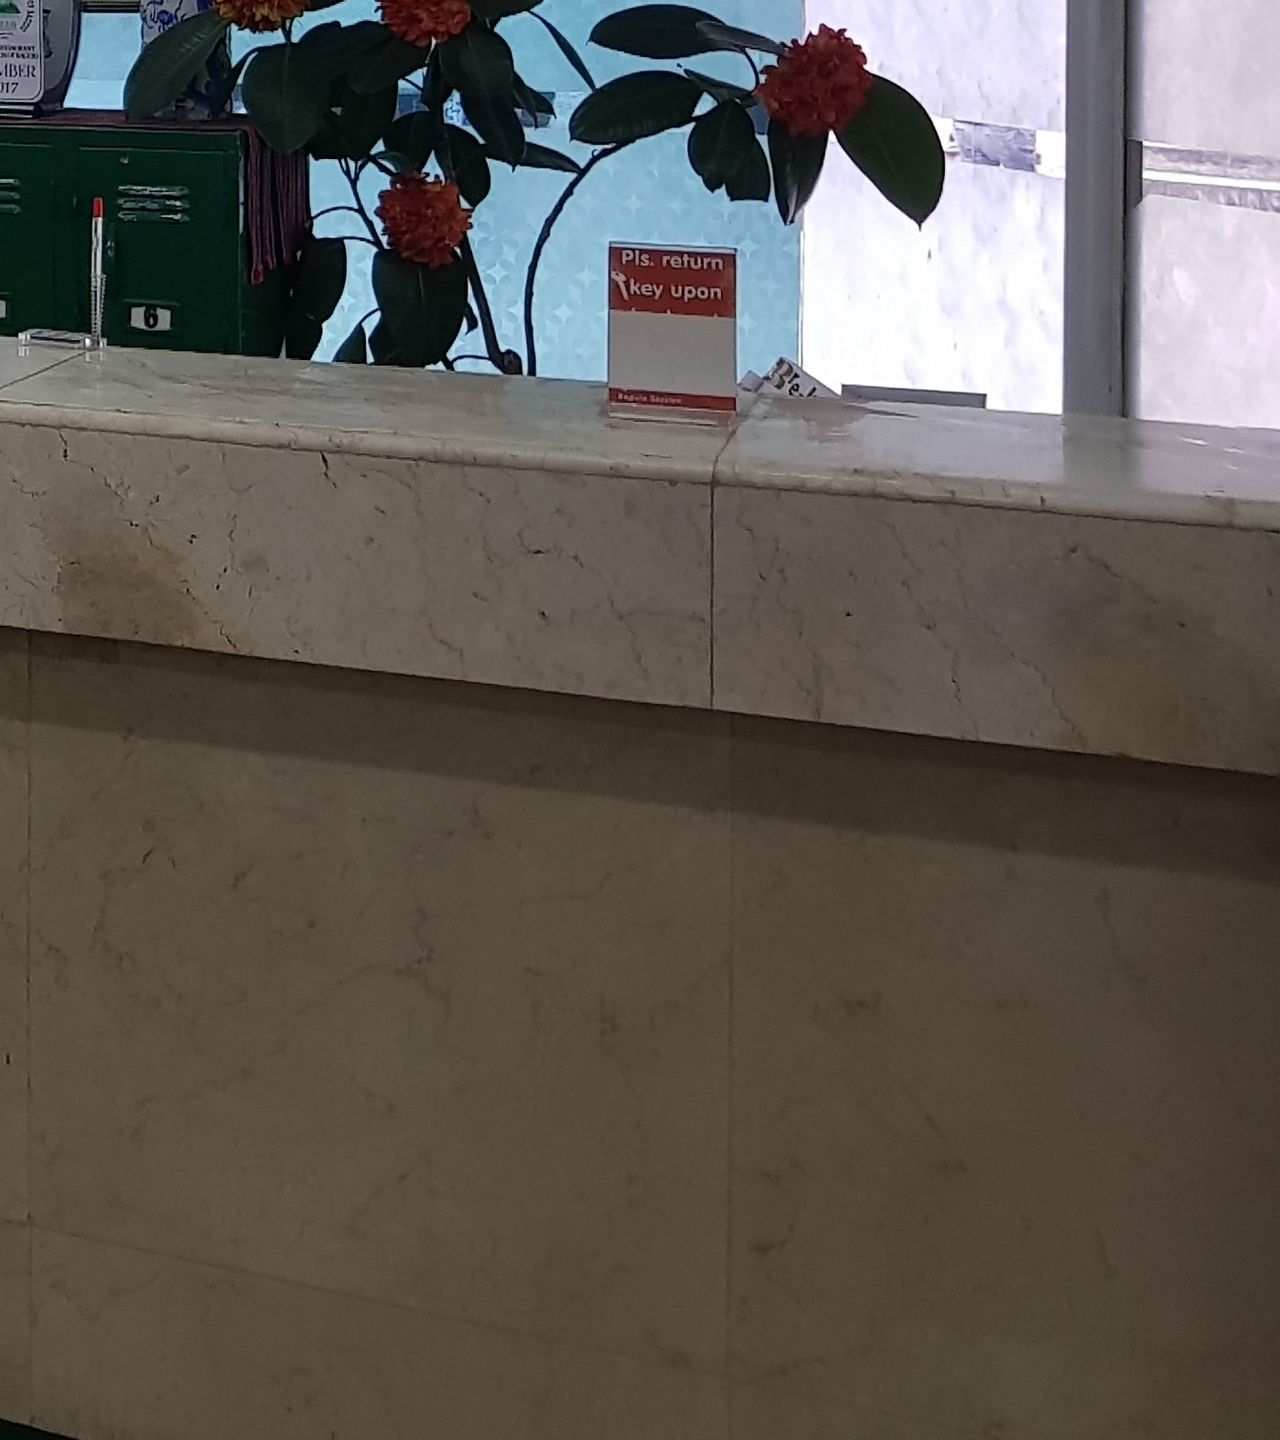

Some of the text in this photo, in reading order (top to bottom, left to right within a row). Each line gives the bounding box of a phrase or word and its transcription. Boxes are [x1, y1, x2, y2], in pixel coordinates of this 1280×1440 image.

[621, 249, 724, 270] Pls. return
[629, 279, 722, 302] key upon
[144, 307, 159, 329] 6
